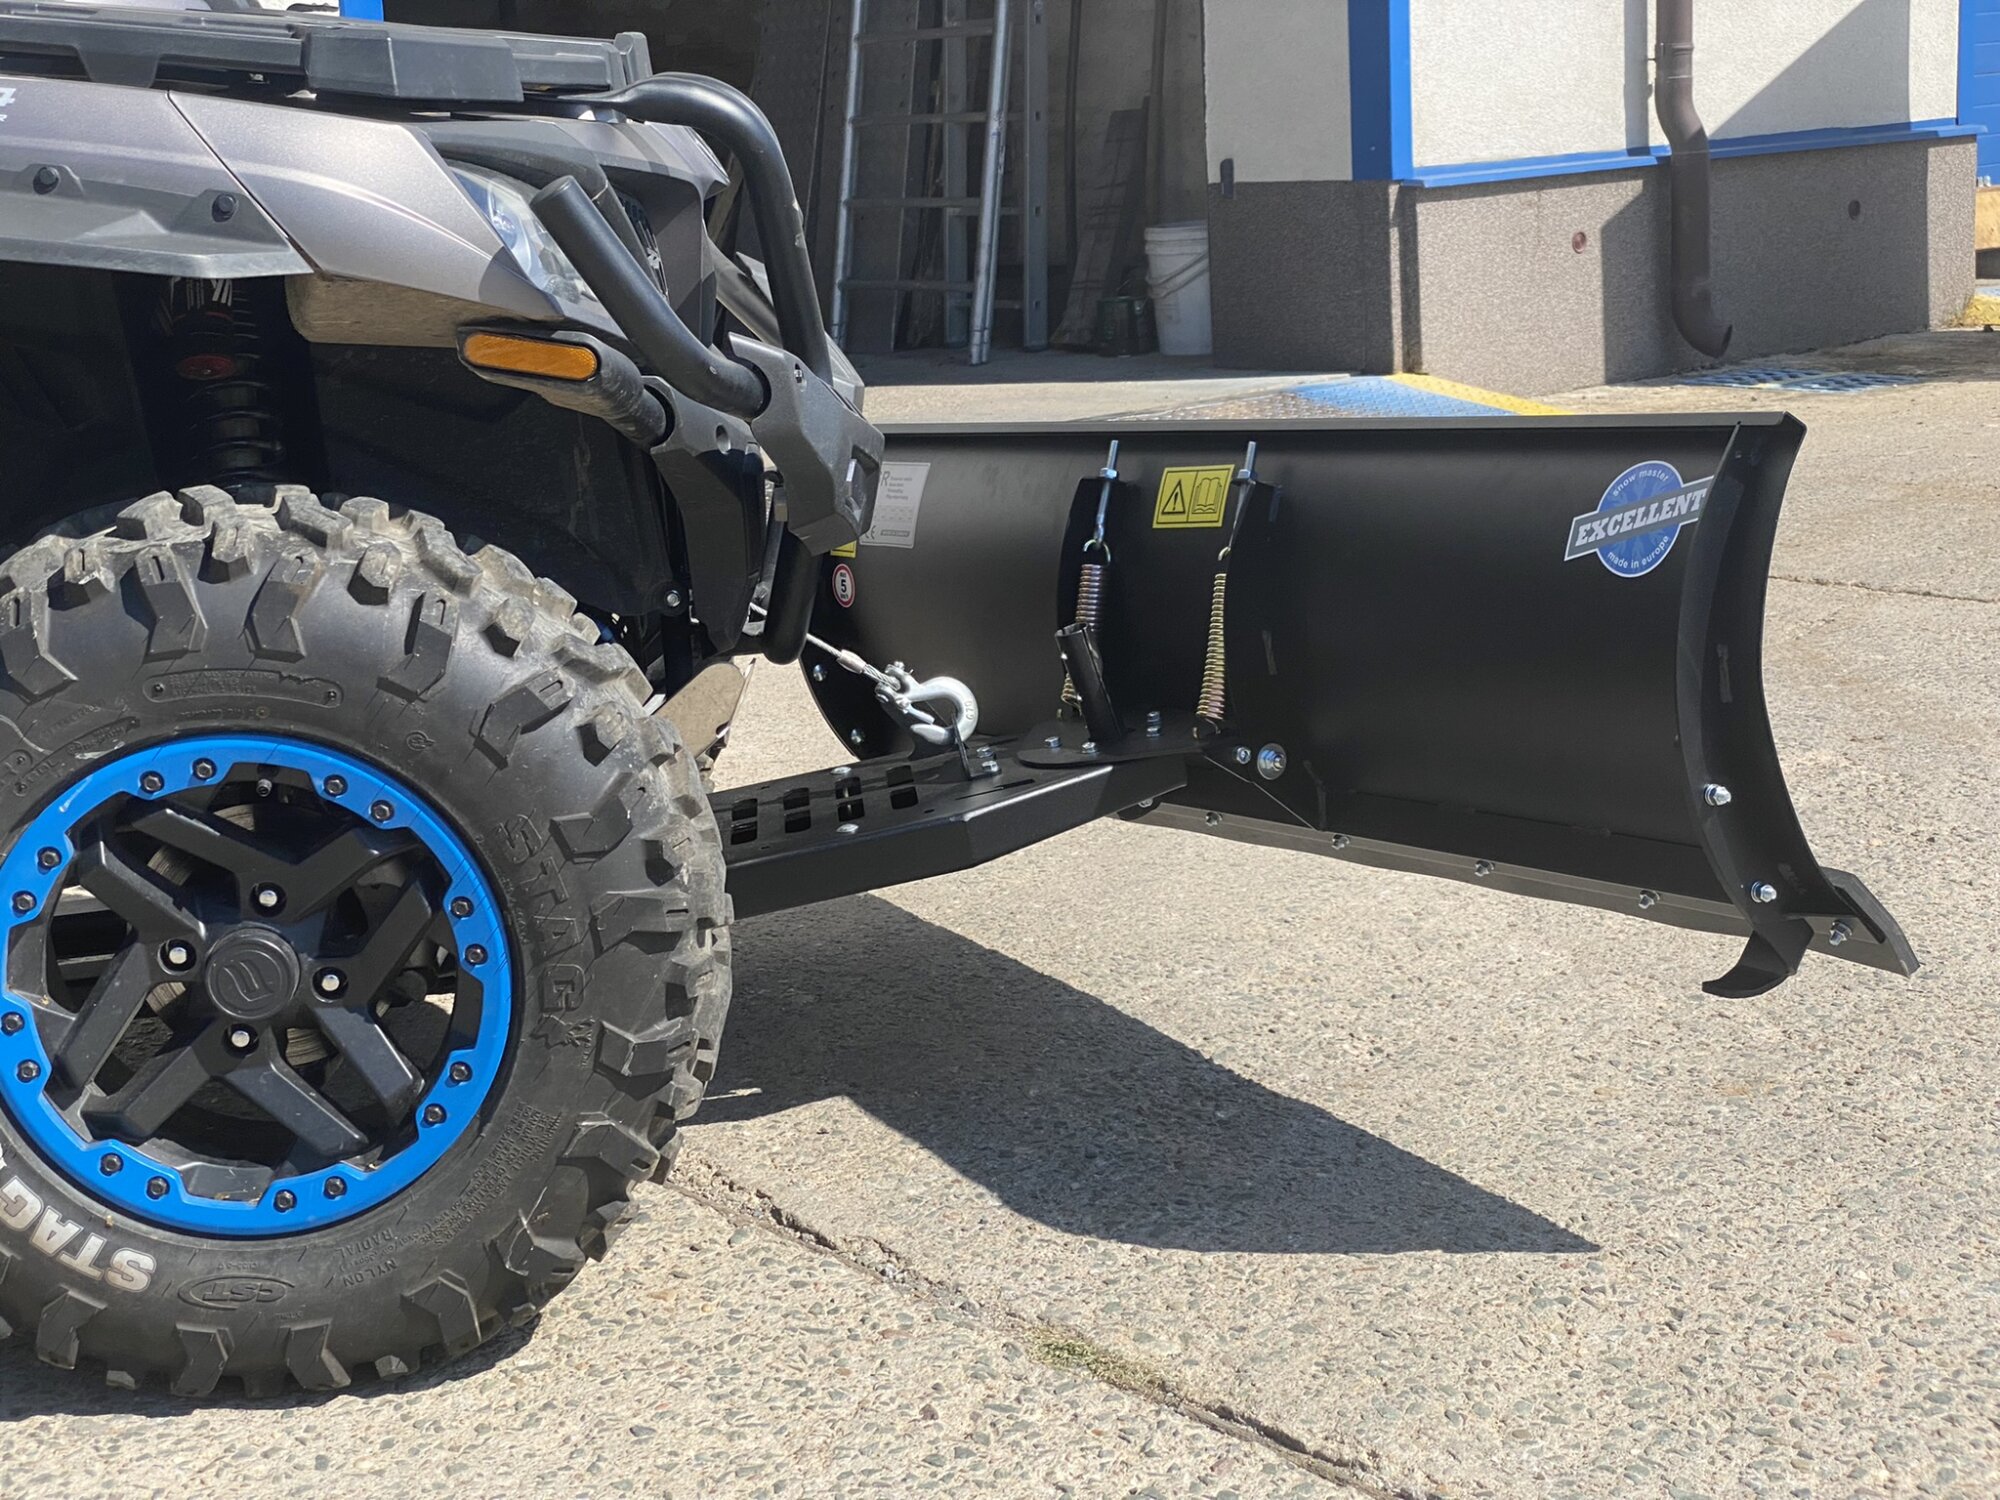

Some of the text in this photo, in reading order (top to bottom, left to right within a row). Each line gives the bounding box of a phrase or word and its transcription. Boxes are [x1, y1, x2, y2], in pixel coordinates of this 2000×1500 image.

[1613, 469, 1669, 497] snow master
[1575, 488, 1707, 546] EXCELLENT
[1607, 536, 1669, 568] made in europe
[841, 579, 847, 593] 5
[494, 814, 585, 1011] STAG
[0, 1176, 157, 1292] STAG
[334, 1225, 395, 1262] RADIAL
[341, 1256, 398, 1290] NYLON
[201, 1278, 287, 1304] CST
